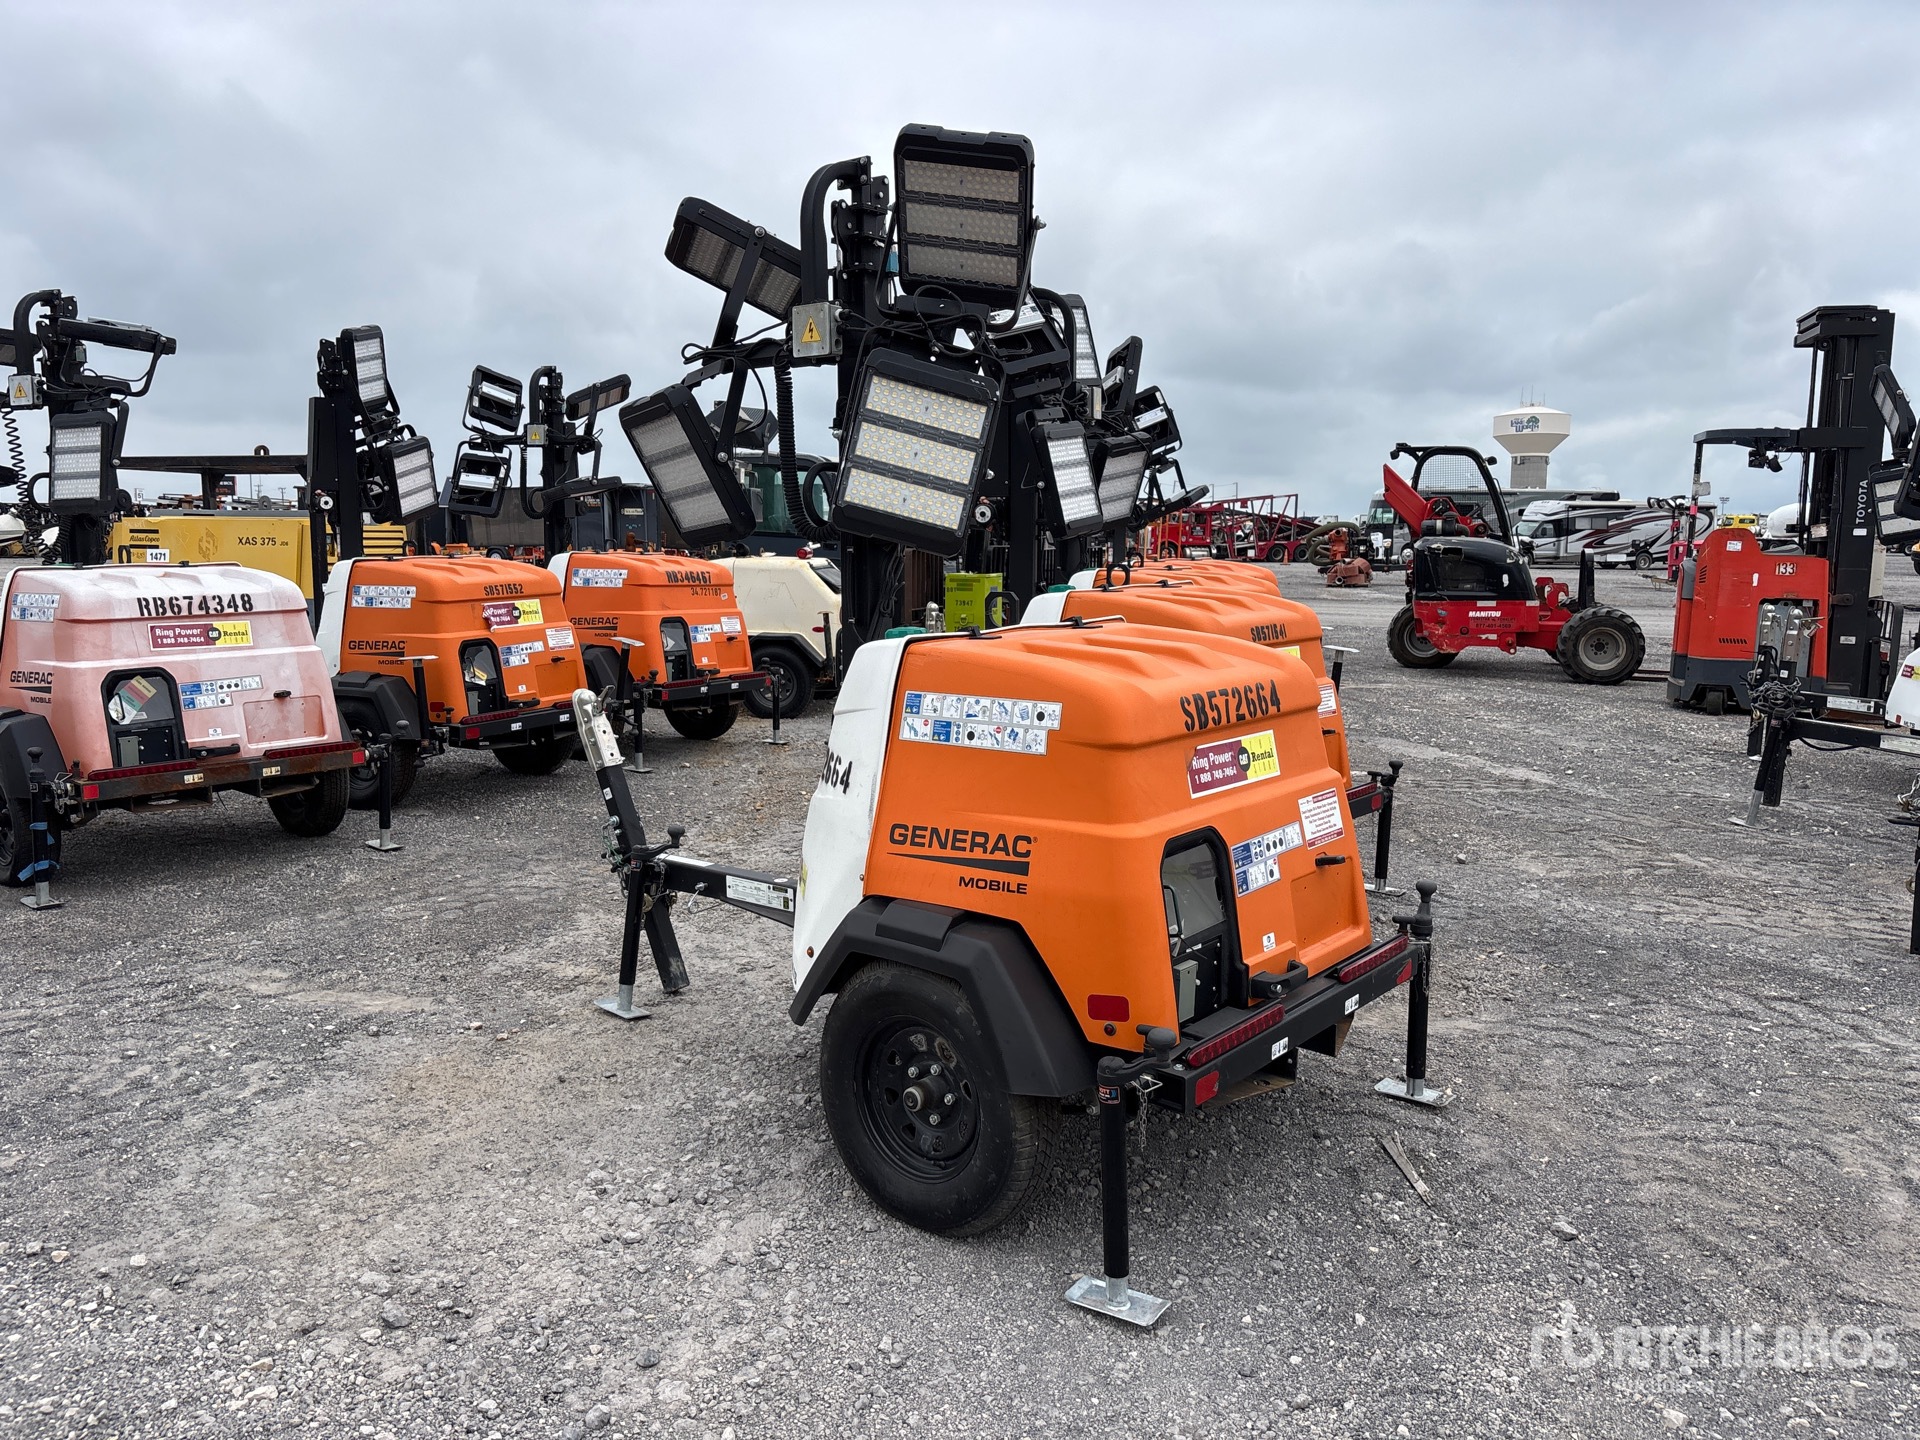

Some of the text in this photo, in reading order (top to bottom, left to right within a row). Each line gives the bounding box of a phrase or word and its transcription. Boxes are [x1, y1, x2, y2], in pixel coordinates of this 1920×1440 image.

[1856, 479, 1868, 524] TOYOTA
[238, 536, 258, 546] XAS
[260, 536, 277, 546] 375
[149, 552, 167, 561] 1471
[1776, 563, 1796, 574] 133
[483, 583, 524, 596] SB571552
[136, 593, 254, 617] RB674348
[490, 607, 508, 615] Power
[570, 616, 619, 626] GENERAC
[155, 628, 248, 638] Ring Power CAT Rental
[348, 640, 406, 650] GENERAC
[10, 670, 53, 684] GENERAC
[30, 696, 52, 704] MOBILE
[1180, 679, 1281, 732] SB572664
[1192, 747, 1274, 770] Ring Power CAT Rental
[1200, 771, 1212, 784] 888
[1212, 765, 1237, 781] 748-7464
[889, 823, 1032, 859] GENERAC
[958, 876, 1028, 895] MOBILE
